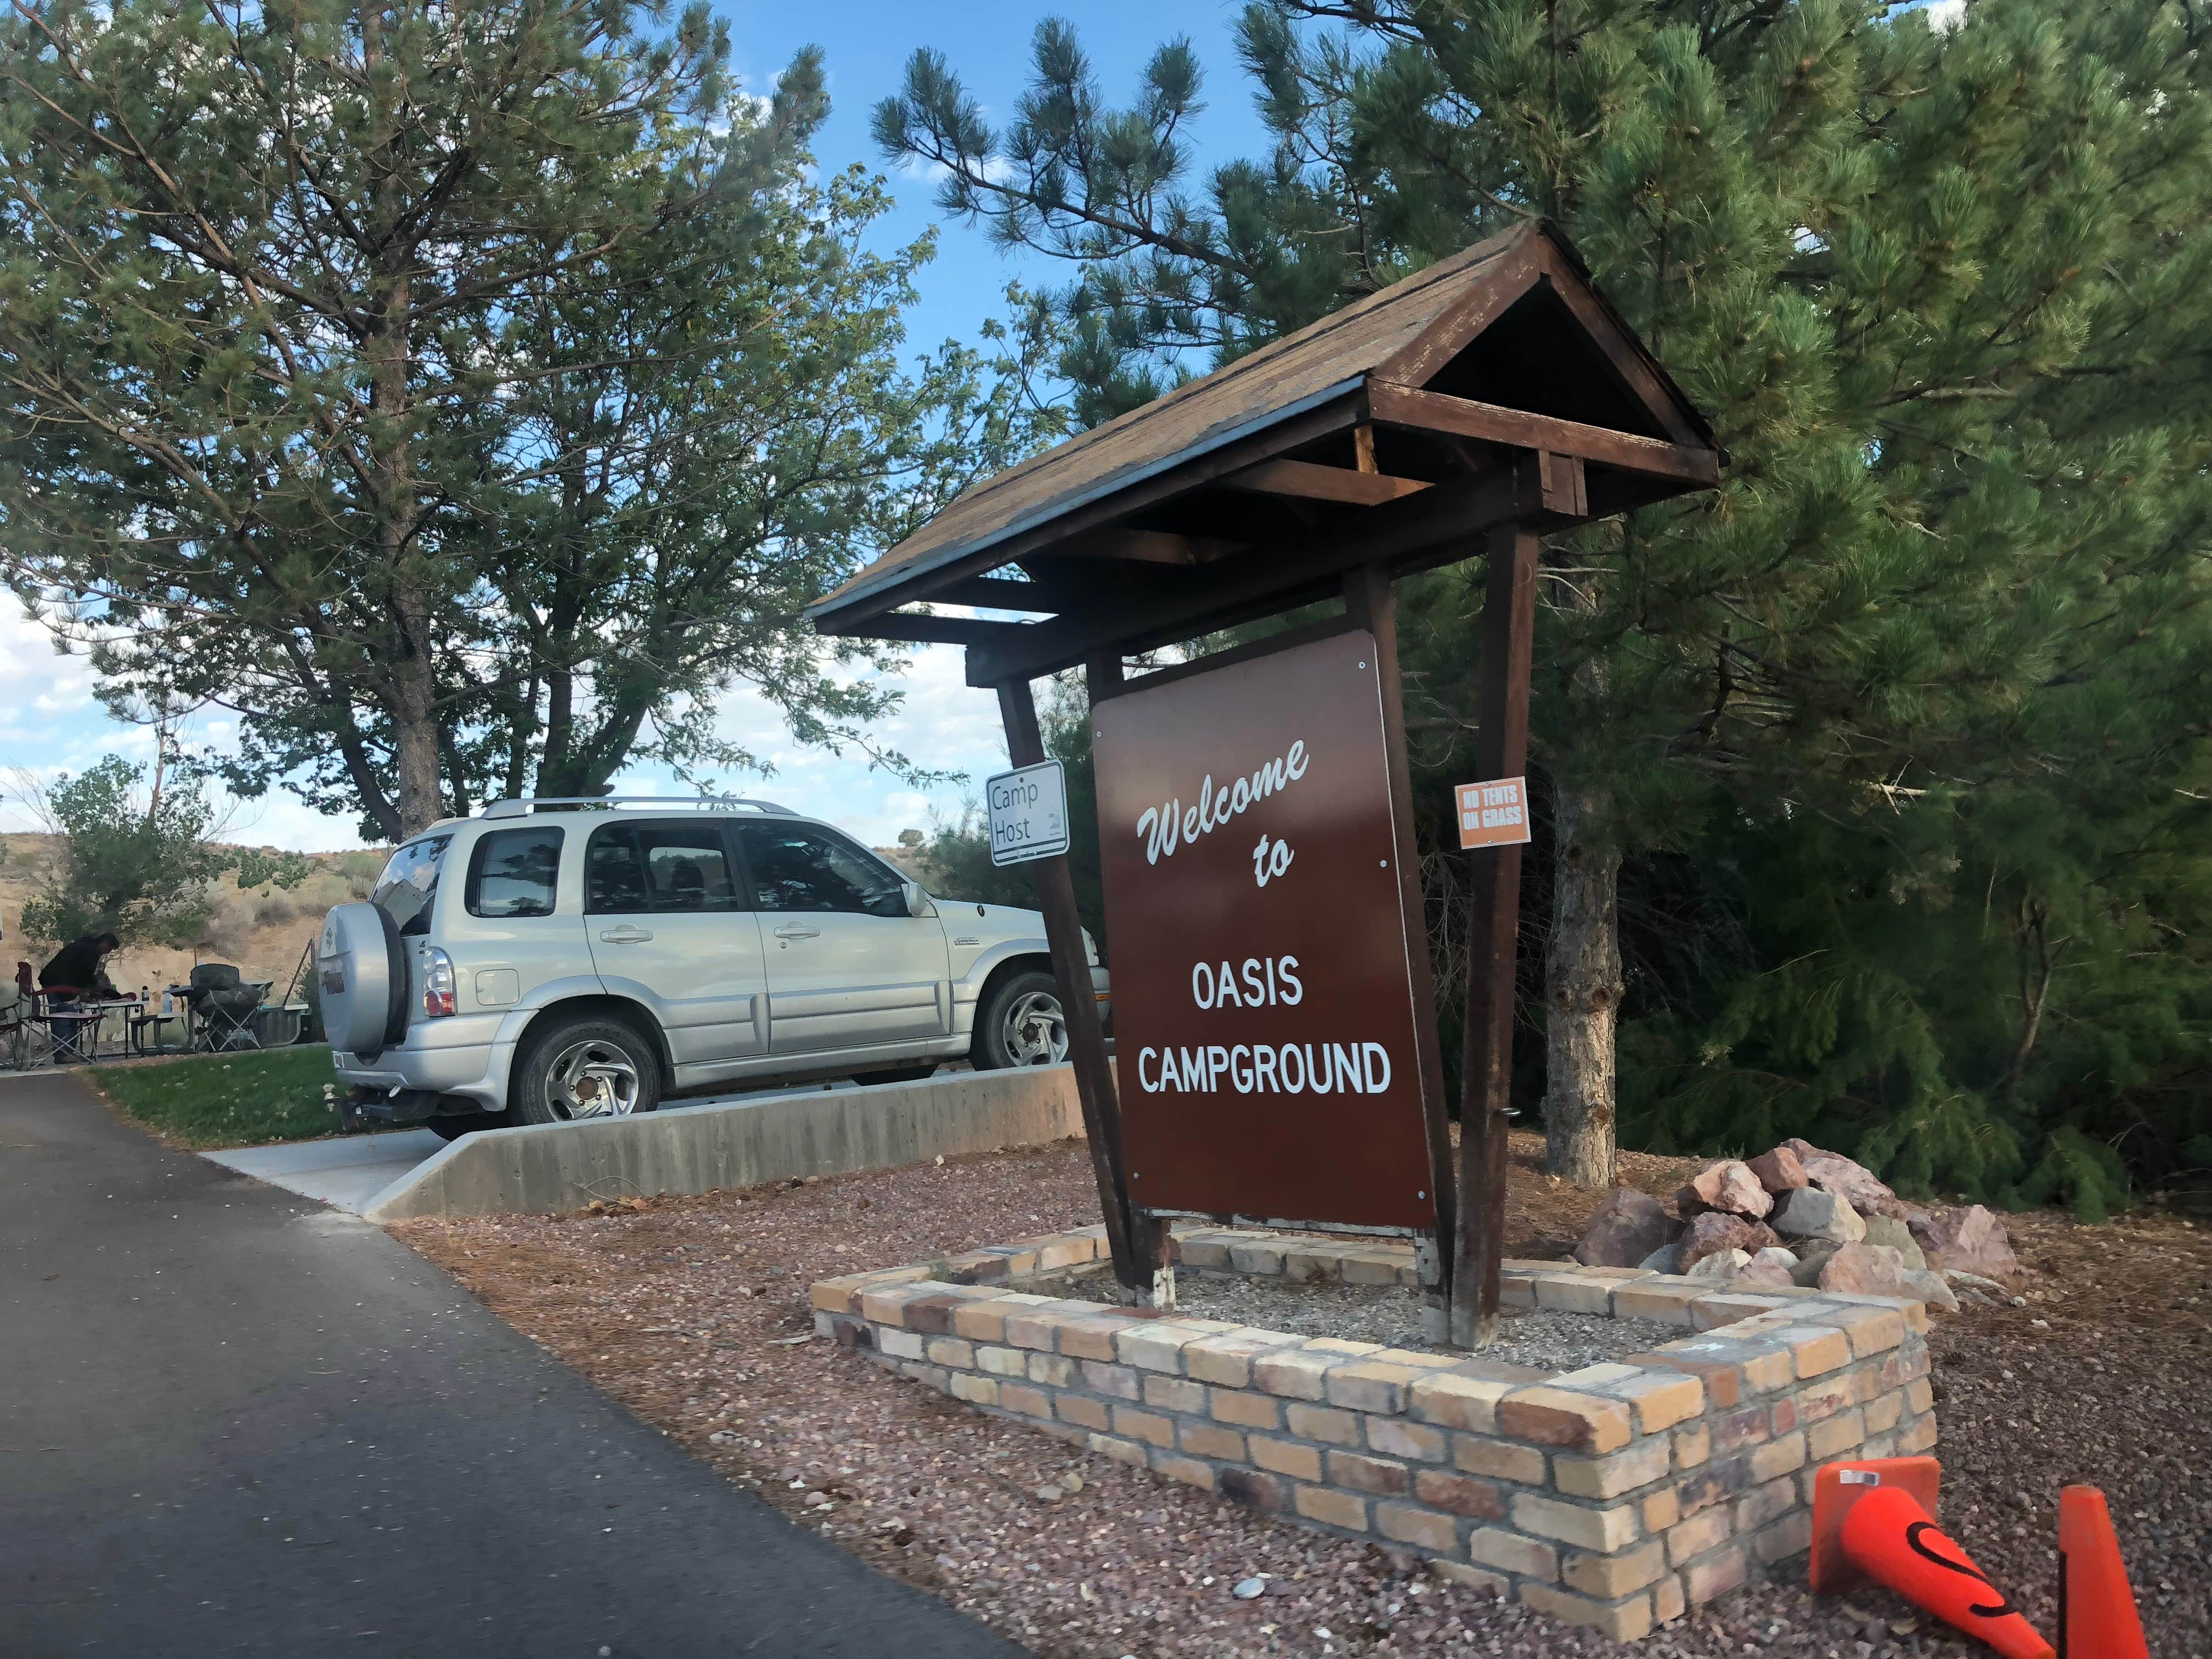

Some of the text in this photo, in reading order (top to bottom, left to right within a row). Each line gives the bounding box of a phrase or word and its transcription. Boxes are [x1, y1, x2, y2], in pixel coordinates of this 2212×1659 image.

[992, 783, 1038, 809] Camp
[1137, 740, 1309, 865] Welcome
[1463, 785, 1517, 809] NO TENTS
[995, 818, 1031, 845] Host
[1463, 806, 1522, 830] ON GRASS
[1254, 834, 1294, 887] to
[1193, 956, 1302, 1009] OASIS
[1139, 1043, 1390, 1093] CAMPGROUND
